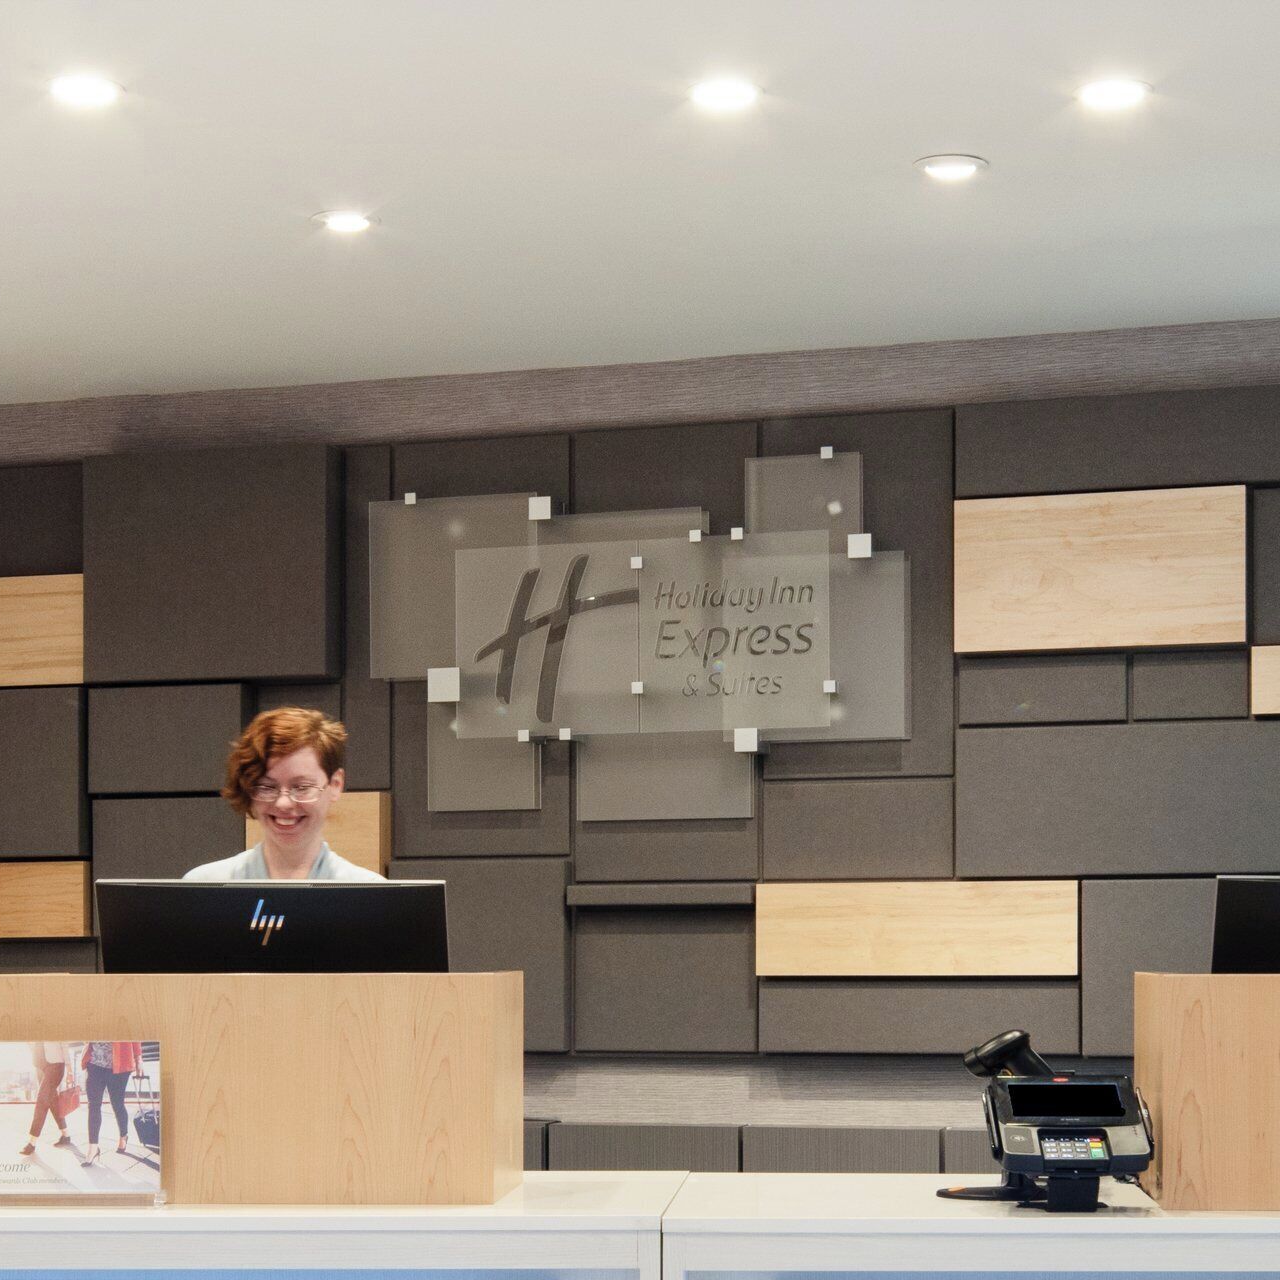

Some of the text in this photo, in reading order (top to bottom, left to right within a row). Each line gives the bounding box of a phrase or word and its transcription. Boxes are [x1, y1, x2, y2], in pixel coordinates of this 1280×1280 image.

[654, 576, 814, 613] Holiday Inn
[655, 620, 814, 668] Express
[682, 671, 783, 697] & Suites
[250, 899, 285, 945] hp
